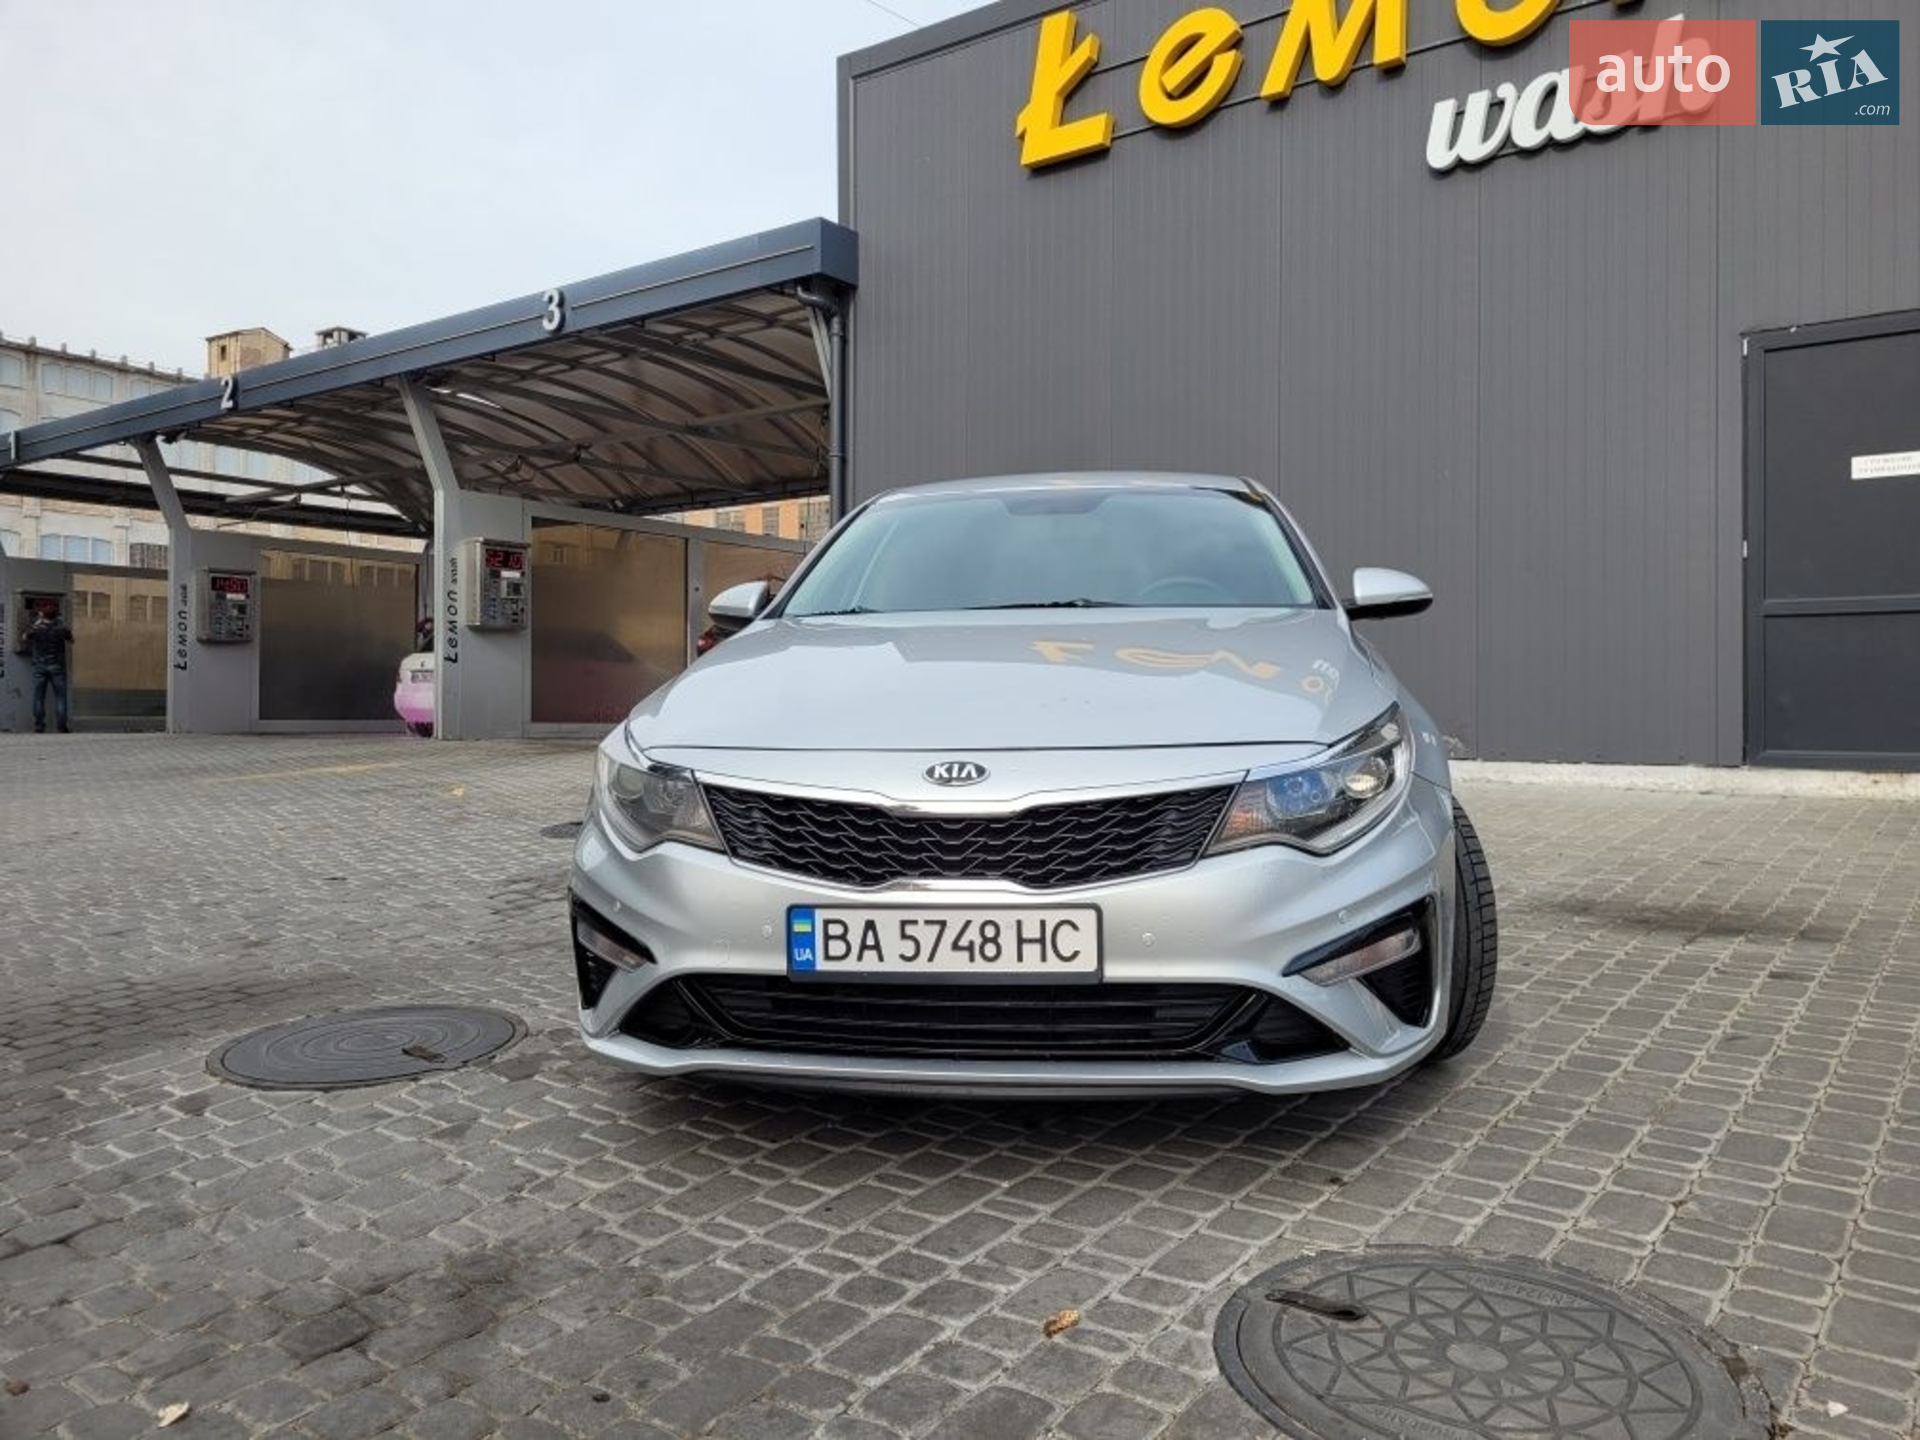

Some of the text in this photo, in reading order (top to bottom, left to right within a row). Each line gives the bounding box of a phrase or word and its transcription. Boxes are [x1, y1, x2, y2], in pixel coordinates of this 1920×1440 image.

[542, 288, 561, 331] 3
[220, 375, 233, 409] 2
[933, 763, 978, 778] KIA
[794, 948, 813, 961] UA
[822, 919, 1080, 962] BA 5748 HC
